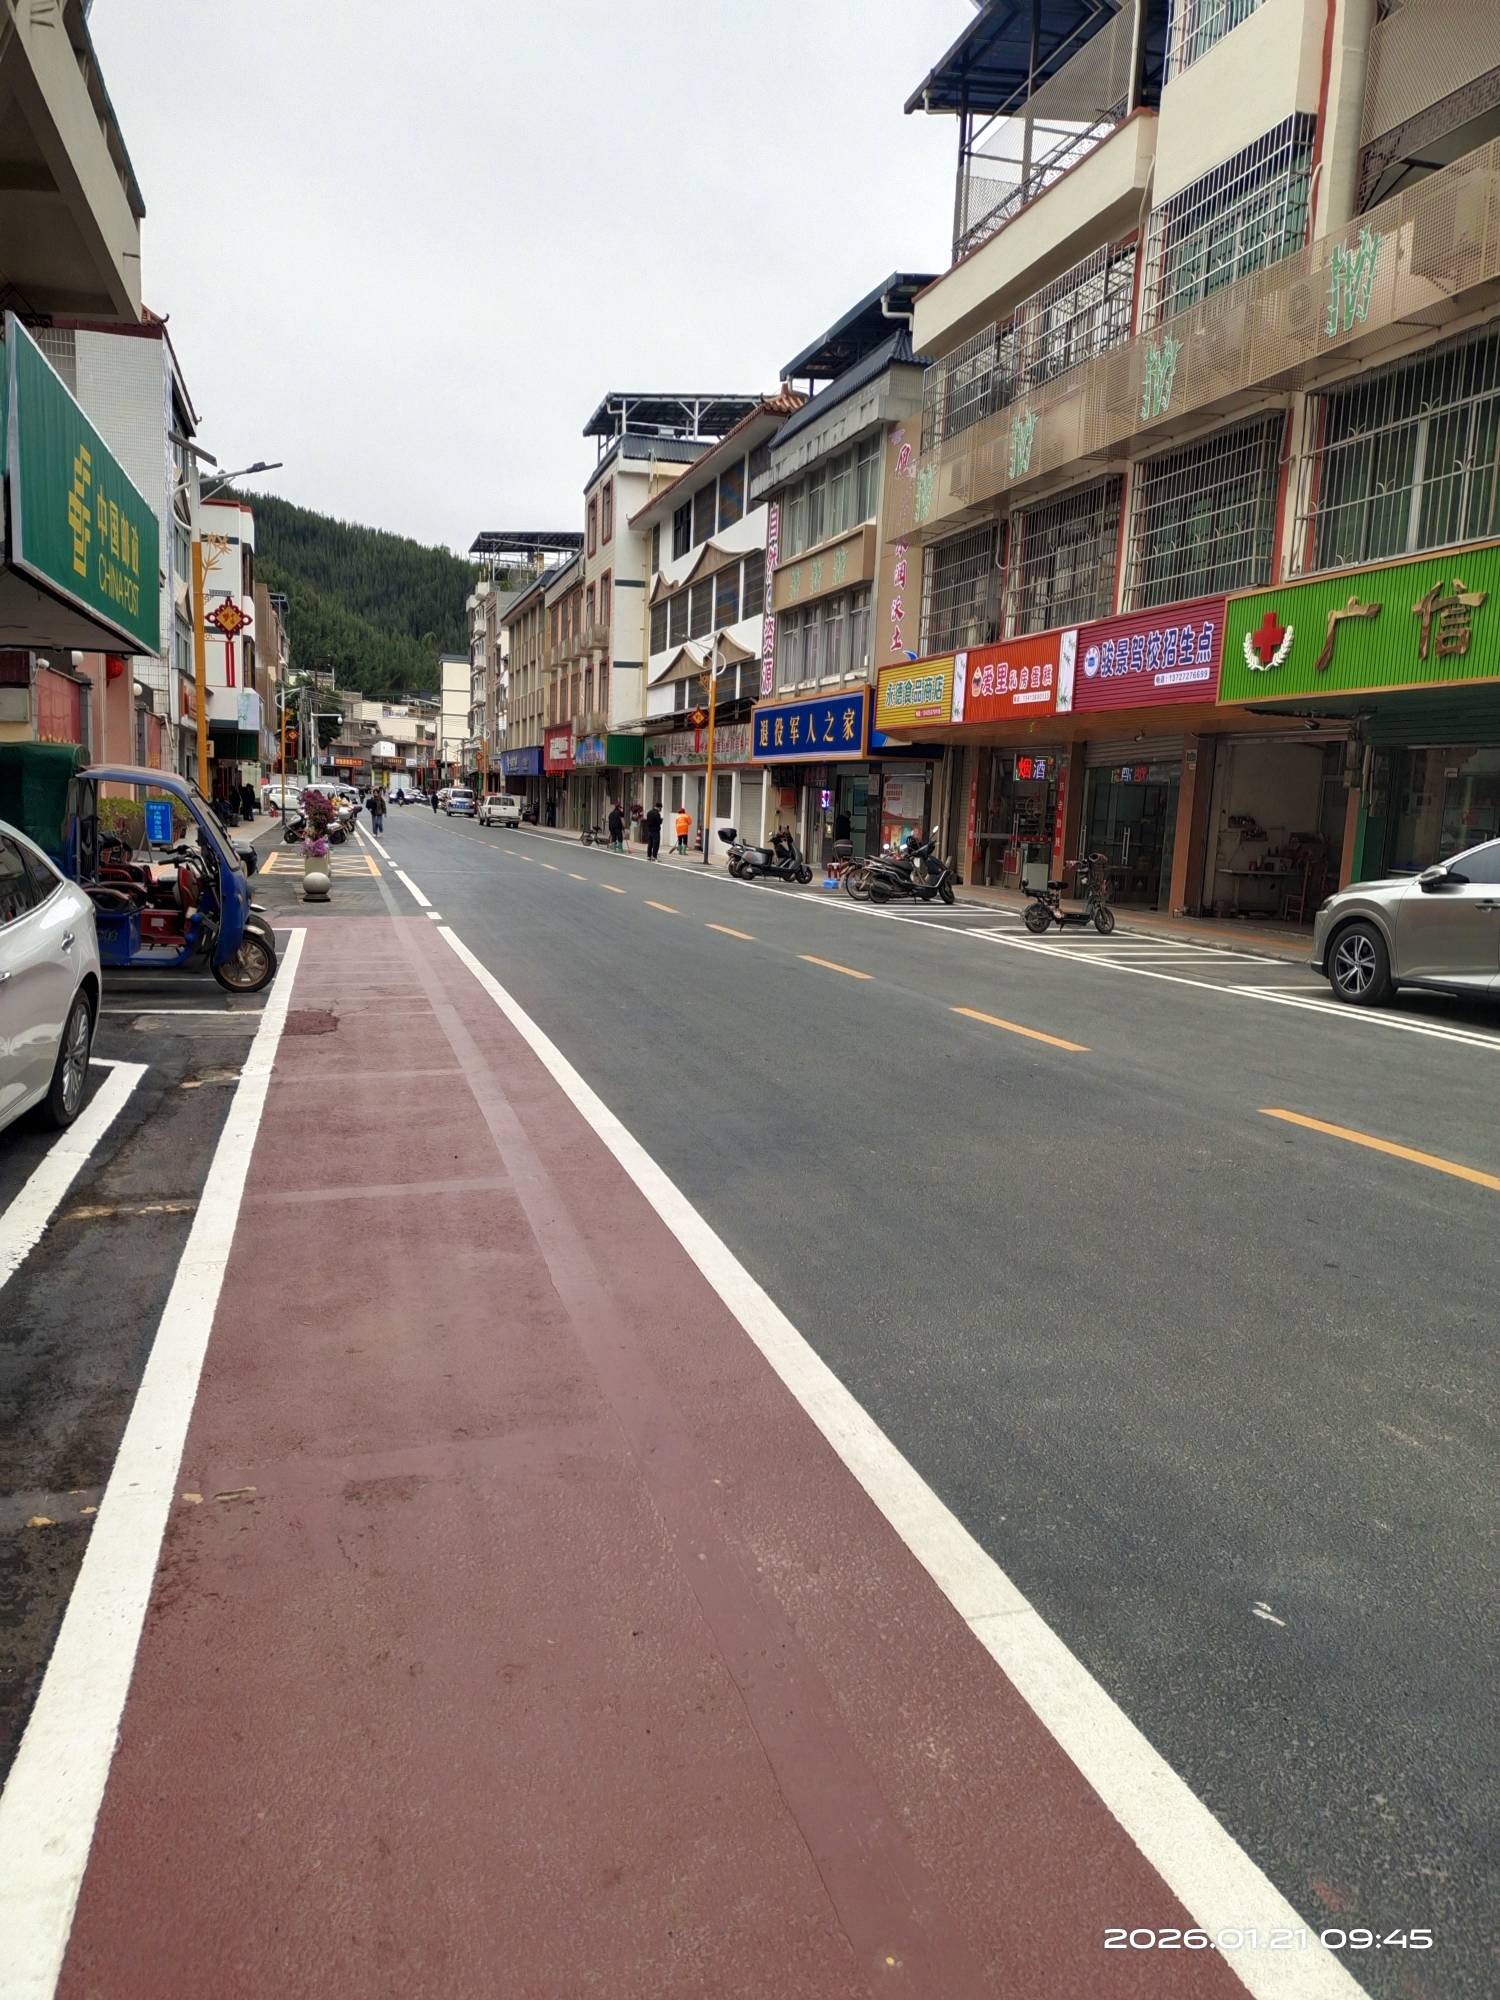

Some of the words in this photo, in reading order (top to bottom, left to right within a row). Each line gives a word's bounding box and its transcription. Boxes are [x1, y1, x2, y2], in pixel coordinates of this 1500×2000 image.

[98, 552, 123, 604] CHINA
[123, 575, 140, 618] POST
[1101, 621, 1214, 677] 骏景驾校招生点
[1315, 578, 1489, 672] 广信
[759, 707, 855, 747] 退役军人之家
